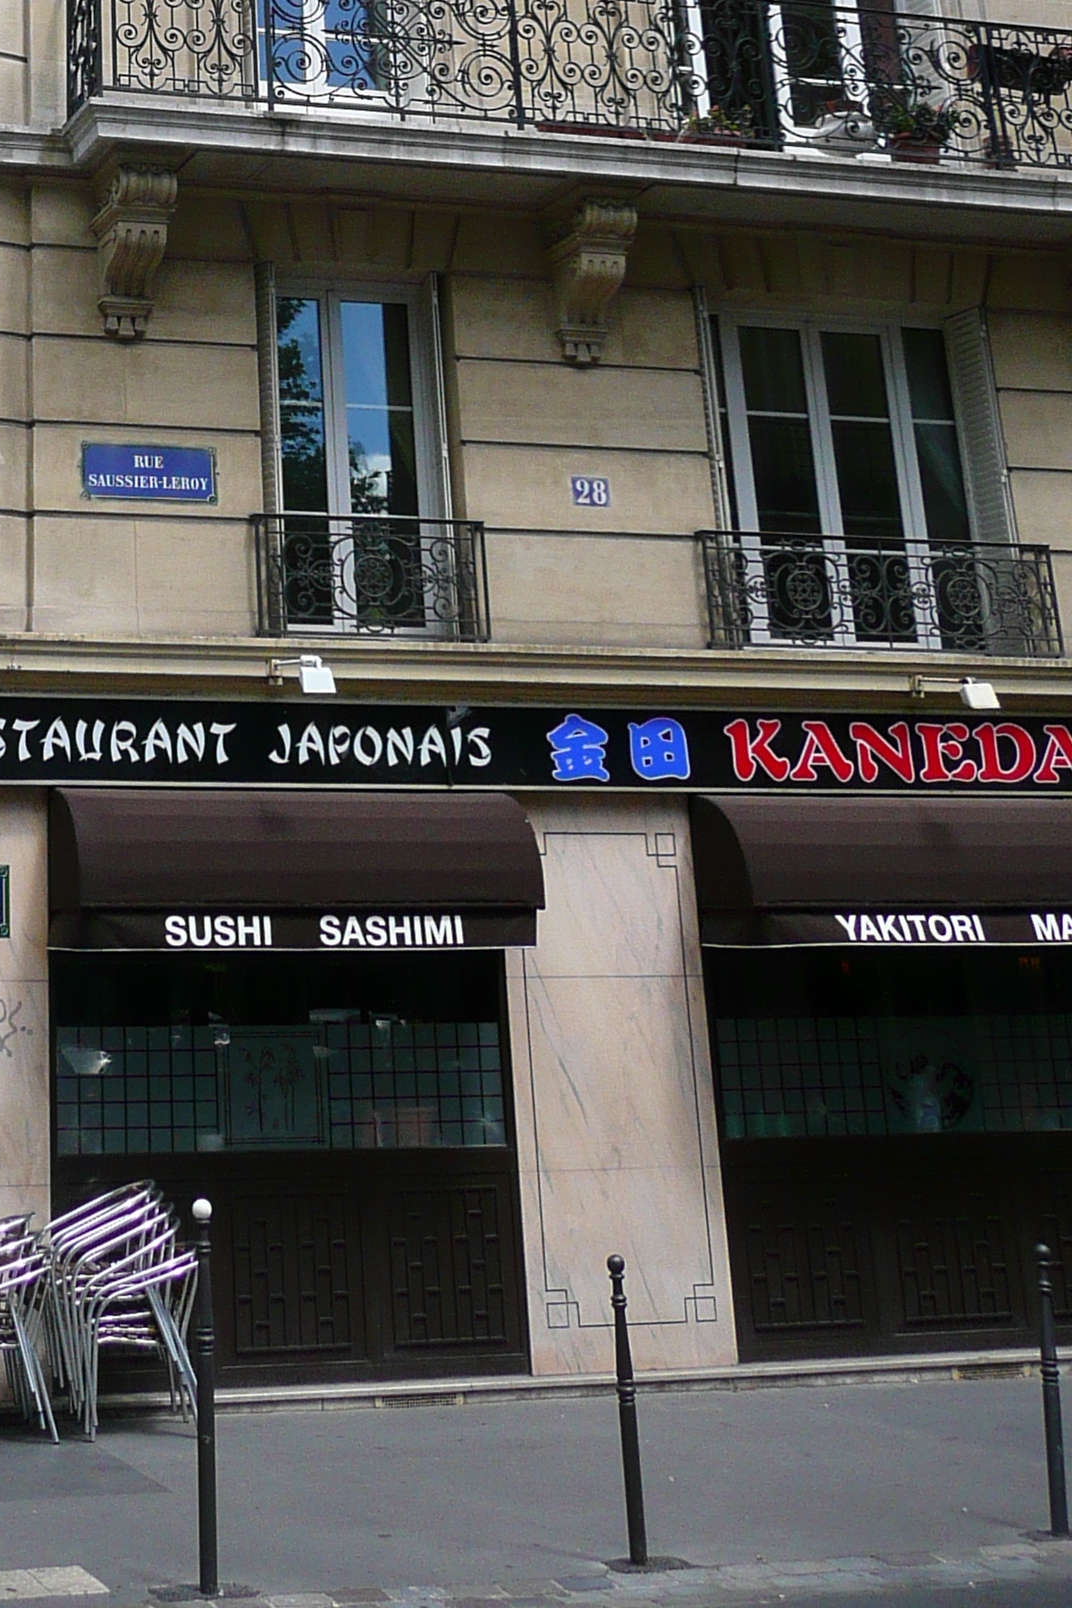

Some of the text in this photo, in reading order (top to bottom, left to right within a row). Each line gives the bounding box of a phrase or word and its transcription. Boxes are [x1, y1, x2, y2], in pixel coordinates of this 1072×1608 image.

[133, 455, 164, 469] RUE
[88, 473, 208, 491] SAUSSIER-LEROY
[575, 478, 607, 505] 28
[268, 721, 493, 767] JAPONAIS
[546, 713, 691, 782] 金田
[724, 718, 1072, 784] KANEDA
[164, 915, 465, 947] SUSHI SASHIMI
[834, 914, 986, 942] YAKITORI
